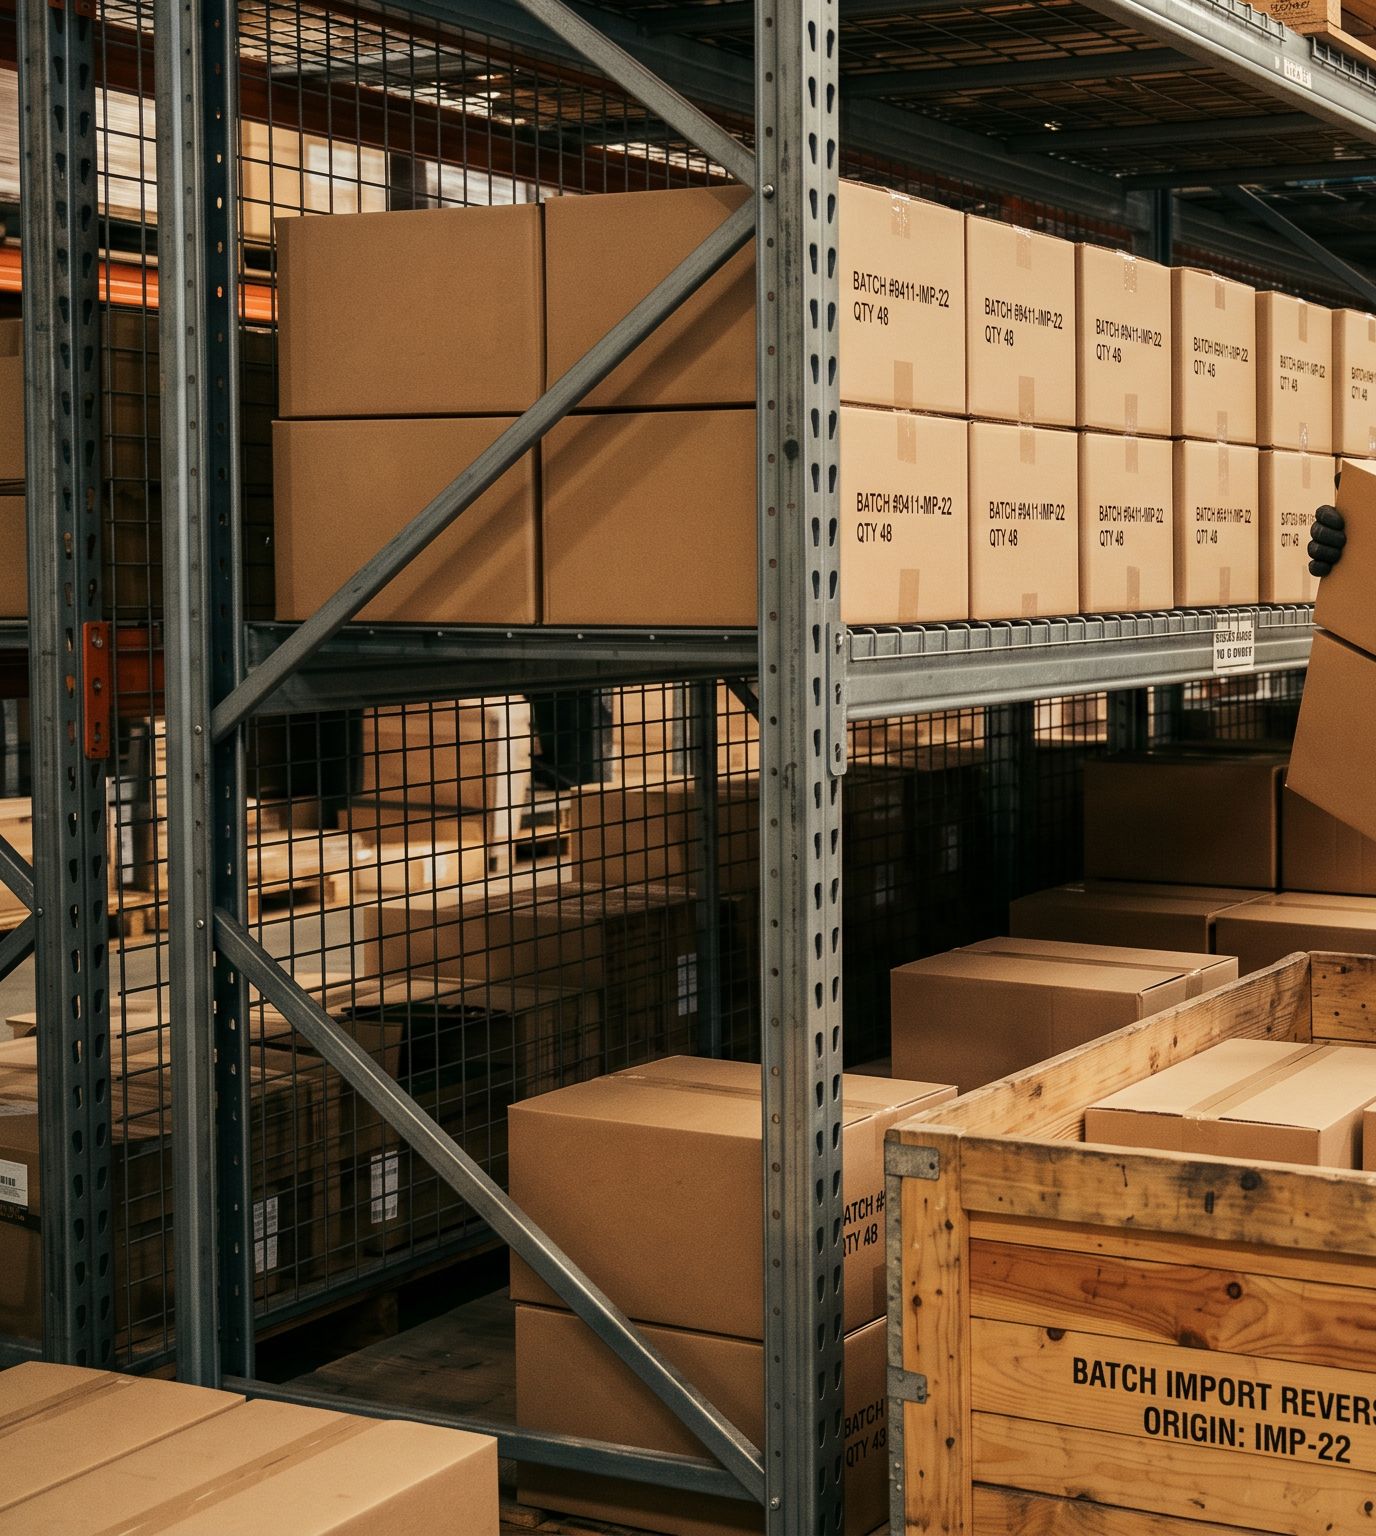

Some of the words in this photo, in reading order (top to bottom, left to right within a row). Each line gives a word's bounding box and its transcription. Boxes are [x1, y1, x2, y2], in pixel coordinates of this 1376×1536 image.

[853, 271, 886, 296] BATCH
[853, 301, 874, 323] QTY
[877, 306, 889, 326] 48
[985, 297, 1012, 319] BATCH
[985, 325, 1001, 344] QTY
[1004, 329, 1014, 347] 48
[1096, 318, 1120, 338] BATCH
[1096, 343, 1111, 360] QTY
[1194, 360, 1206, 375] QTY
[857, 492, 890, 513] BATCH
[989, 501, 1016, 519] BATCH
[1099, 505, 1122, 521] BATCH
[1196, 506, 1216, 522] BATCH
[857, 523, 878, 543] QTY
[880, 523, 892, 543] 48
[989, 528, 1006, 548] QTY
[1008, 529, 1018, 546] 48
[1099, 529, 1114, 547] QTY
[1115, 530, 1124, 546] 48
[843, 1194, 873, 1226] ATCH
[1073, 1356, 1157, 1396] BATCH
[1166, 1370, 1272, 1411] IMPORT
[844, 1398, 884, 1439] BATCH
[1143, 1406, 1245, 1448] ORIGIN:
[1254, 1422, 1351, 1464] IMP-22
[846, 1436, 869, 1468] QTY
